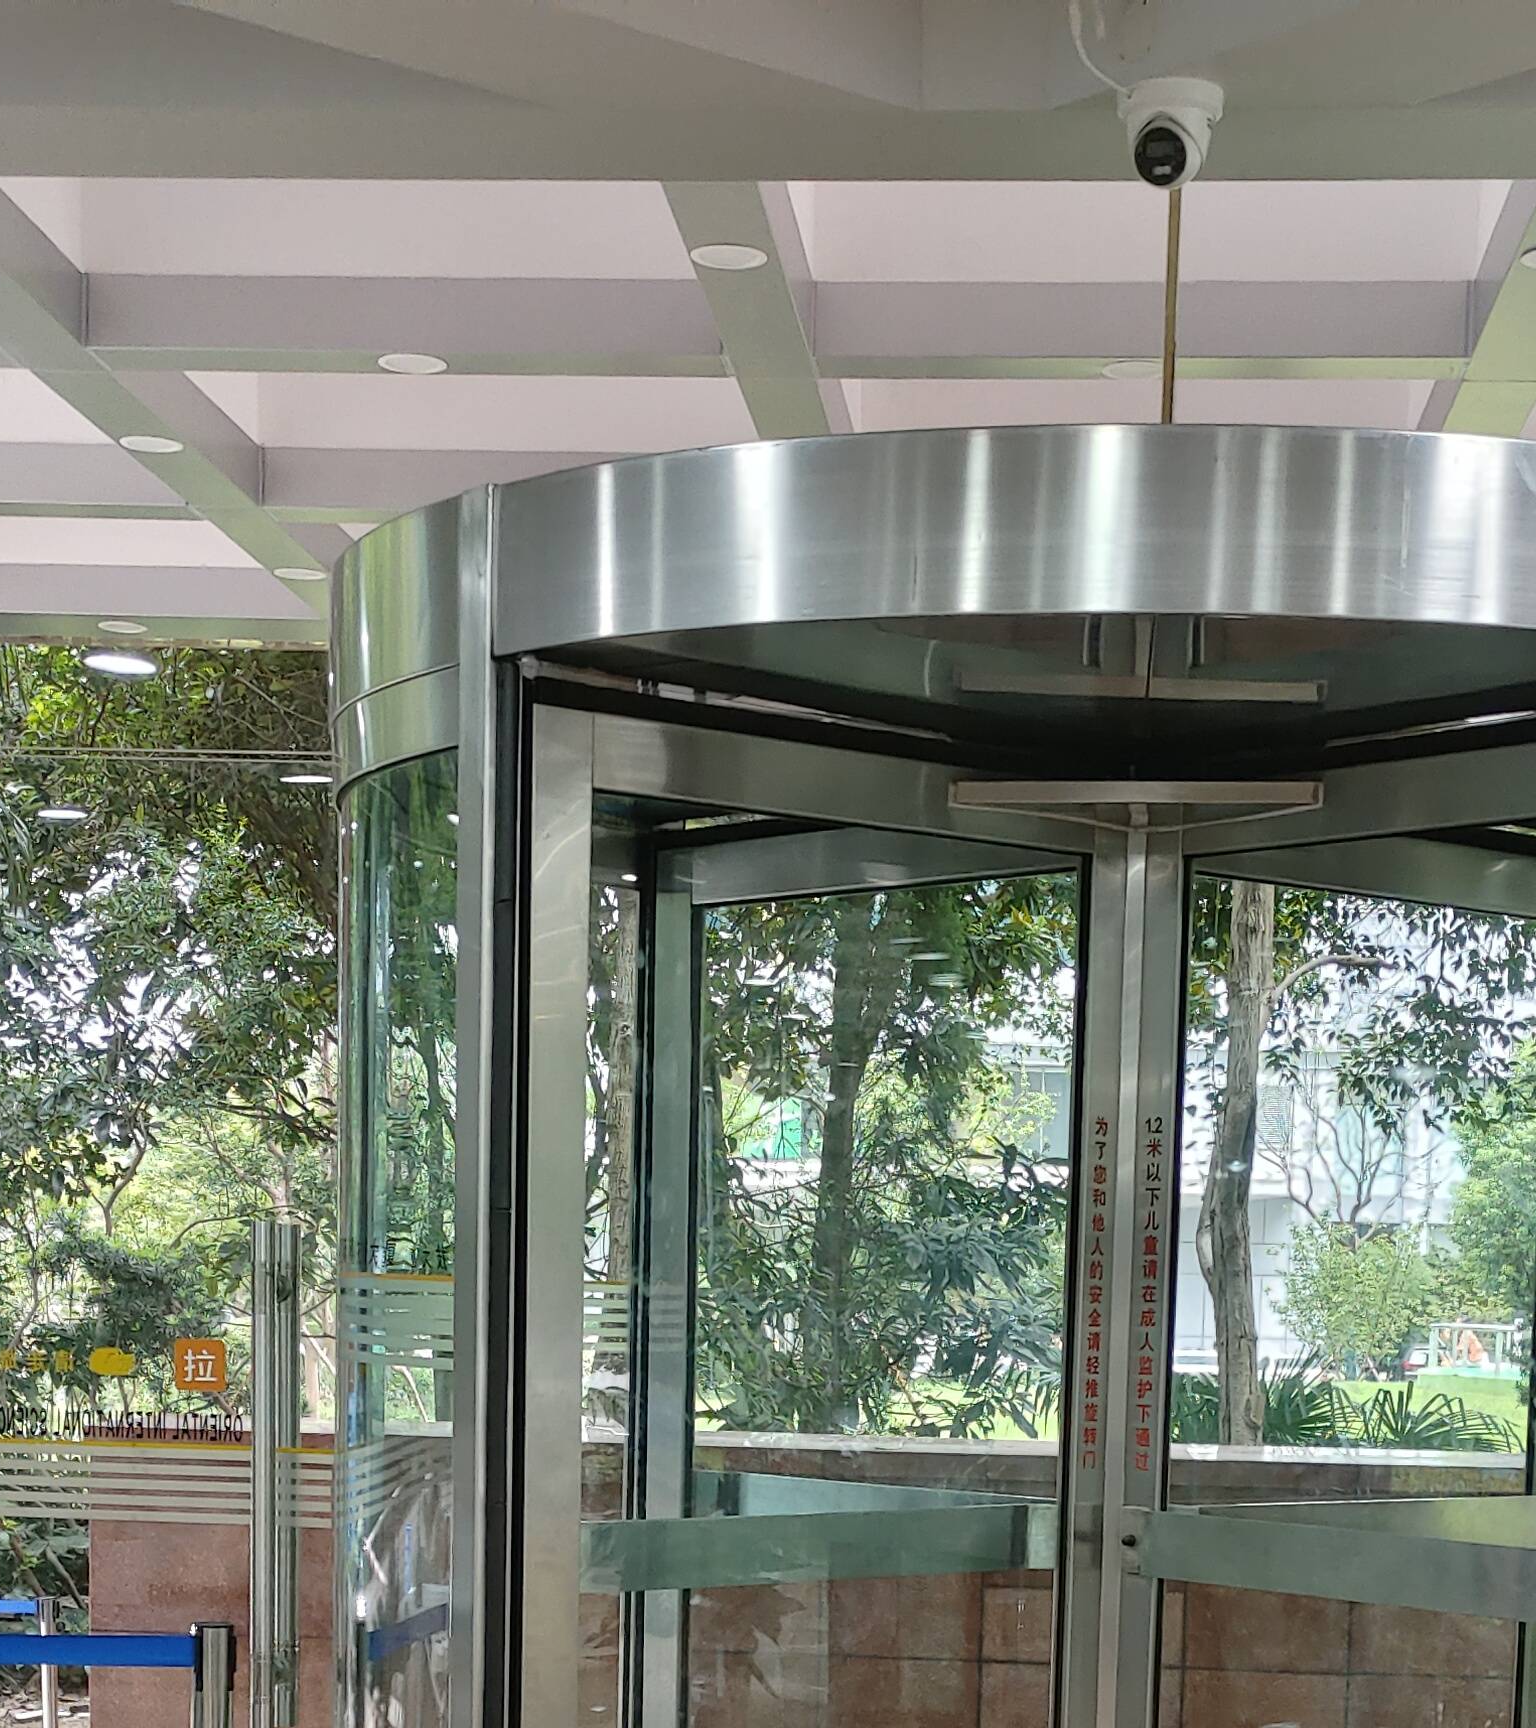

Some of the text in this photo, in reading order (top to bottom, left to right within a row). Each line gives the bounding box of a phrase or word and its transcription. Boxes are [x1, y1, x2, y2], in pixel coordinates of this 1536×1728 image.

[183, 1348, 218, 1382] 拉
[1083, 1116, 1109, 1470] 为了您和他人的安全请轻推旋转门
